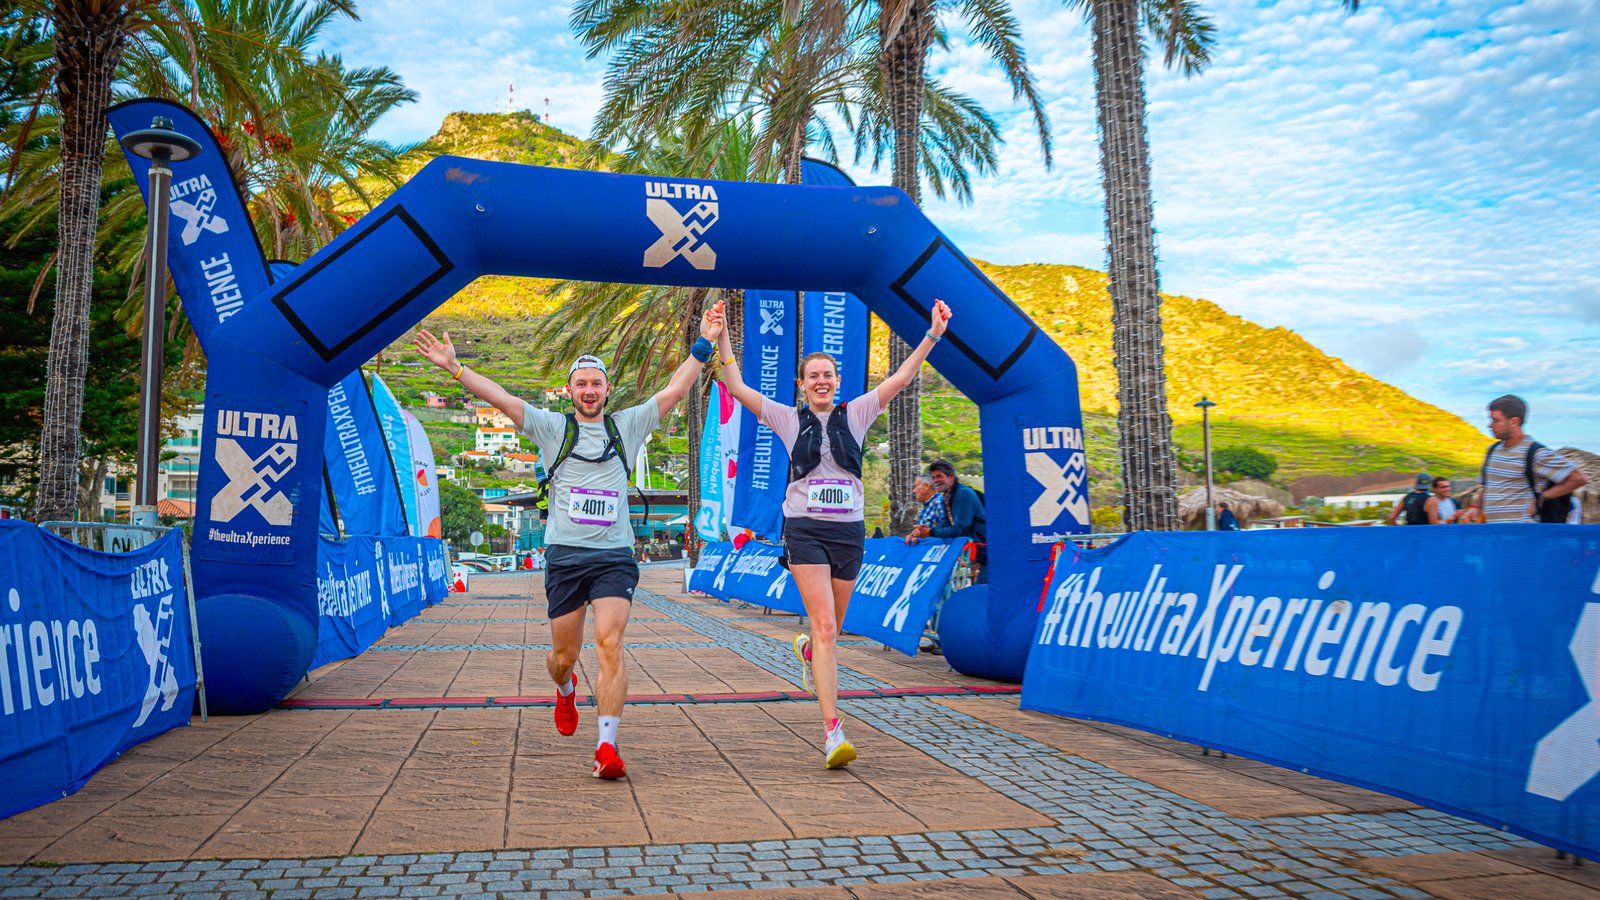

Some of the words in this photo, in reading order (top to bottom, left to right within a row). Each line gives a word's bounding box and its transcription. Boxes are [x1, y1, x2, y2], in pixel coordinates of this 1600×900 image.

[645, 181, 718, 201] ULTRA
[760, 300, 784, 309] ULTRA
[217, 409, 299, 441] ULTRA
[1023, 426, 1085, 451] ULTRA
[819, 489, 843, 504] 4010
[582, 499, 606, 516] 4011
[208, 528, 291, 548] #theultraXperience
[1039, 563, 1464, 692] #theultraXperience
